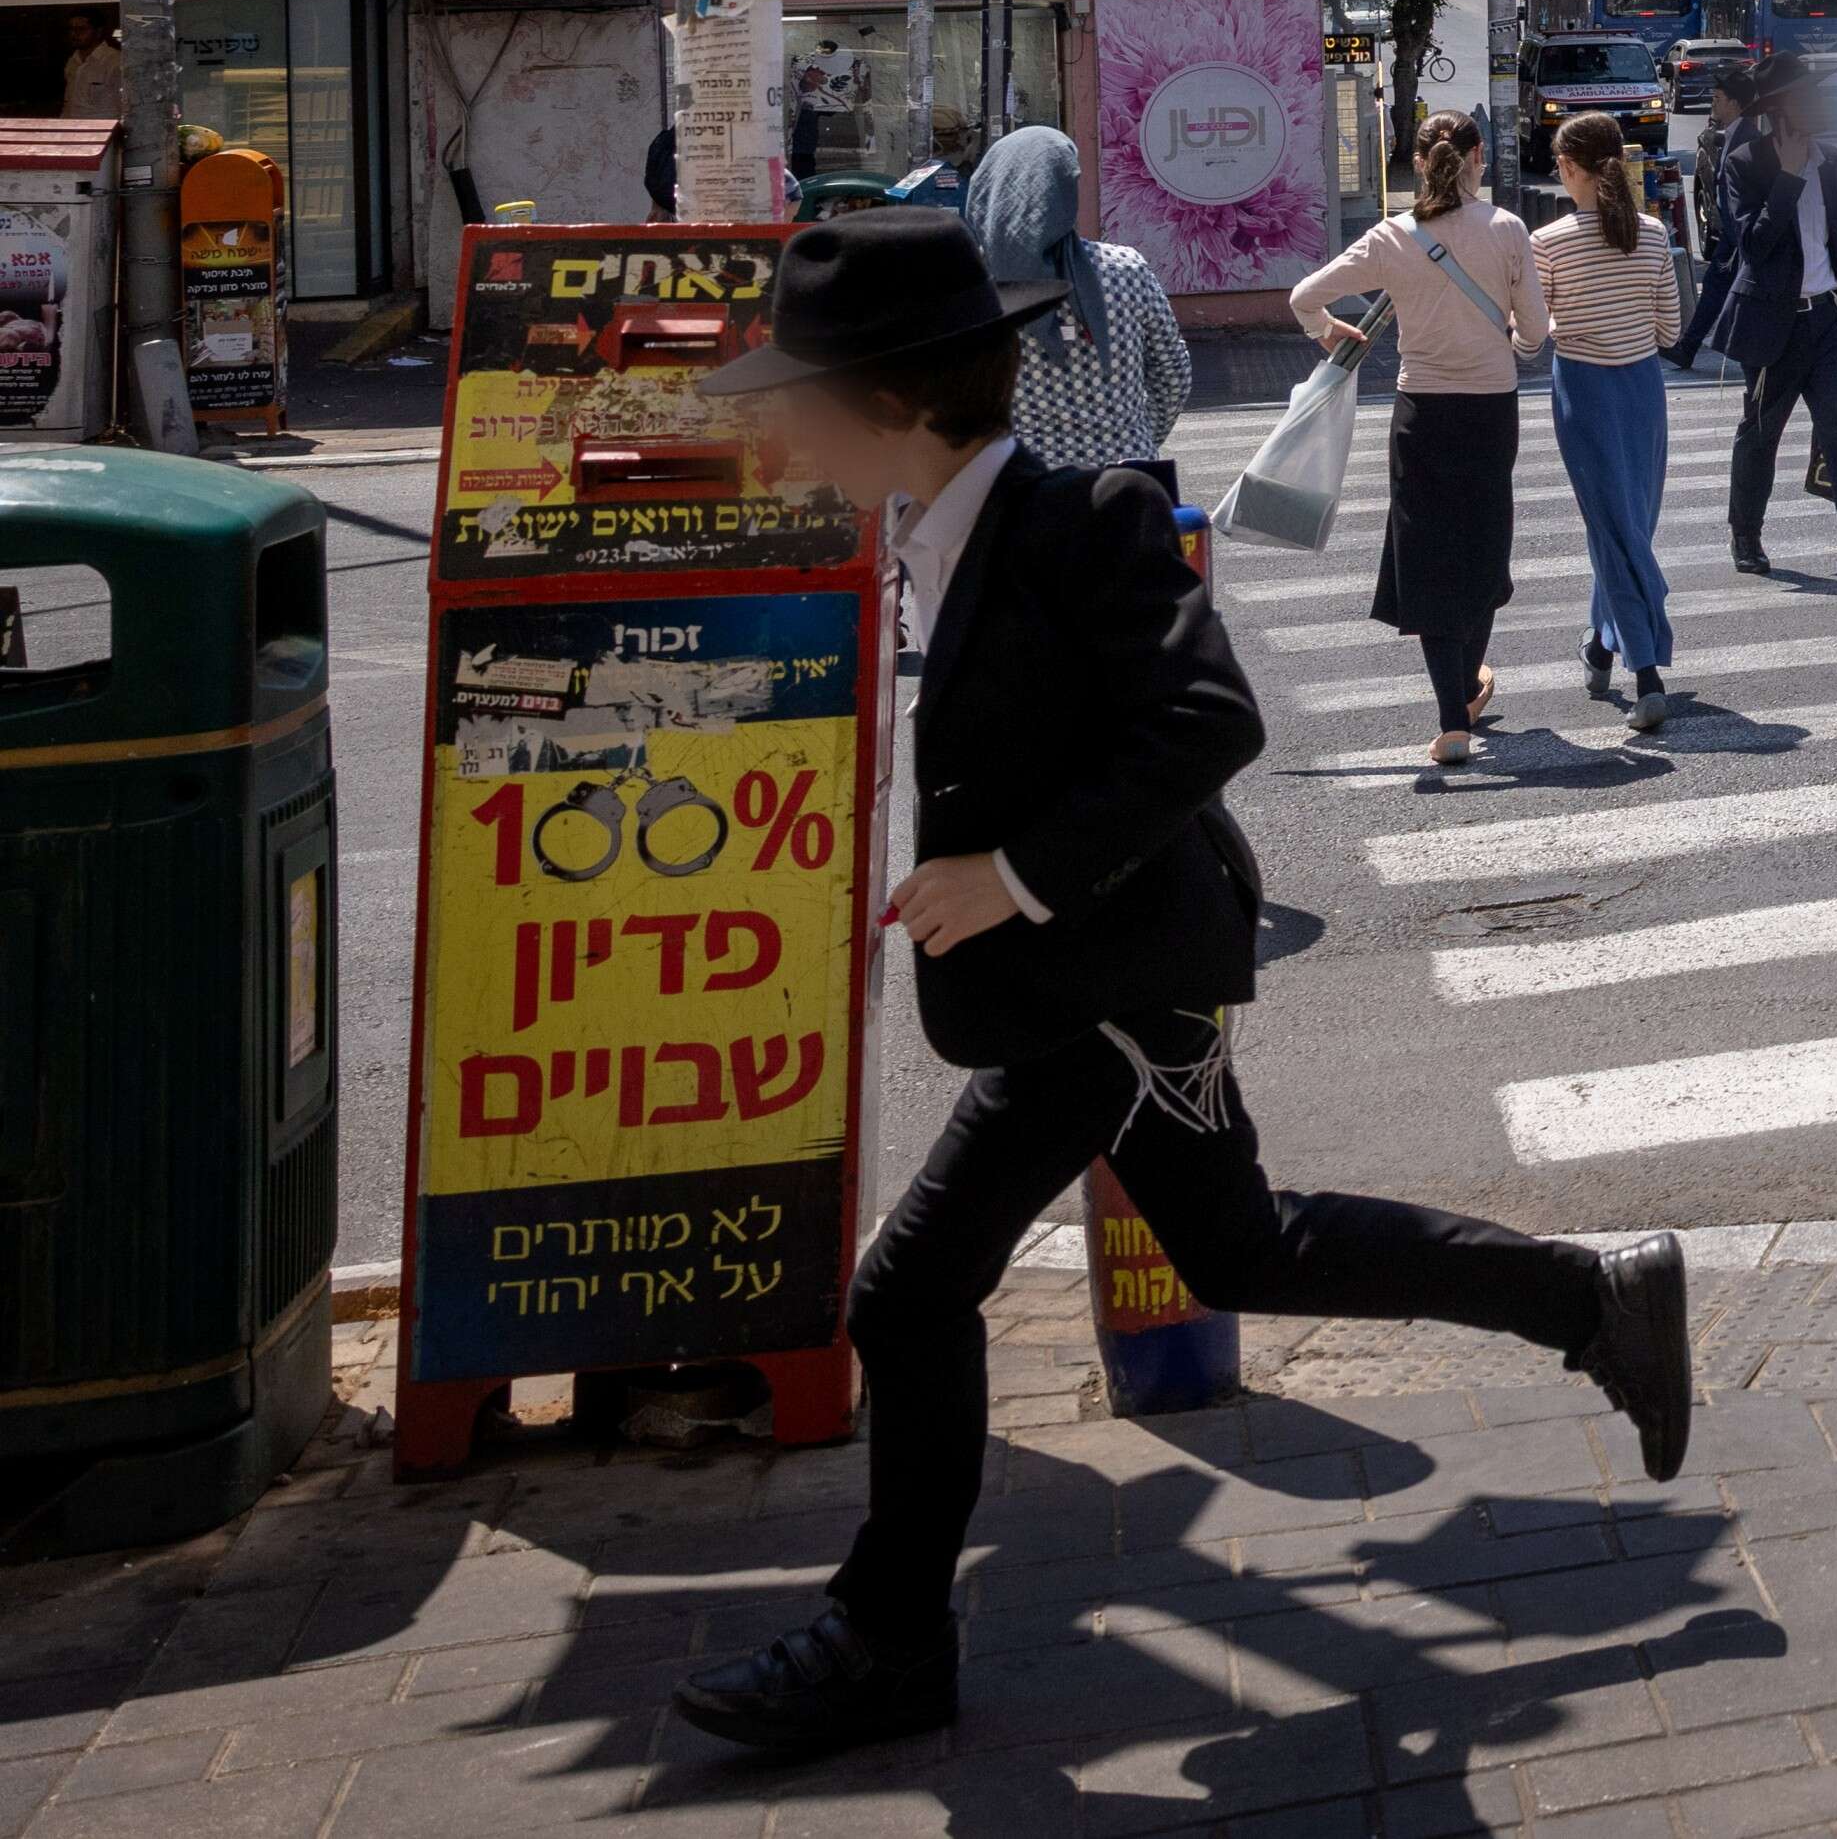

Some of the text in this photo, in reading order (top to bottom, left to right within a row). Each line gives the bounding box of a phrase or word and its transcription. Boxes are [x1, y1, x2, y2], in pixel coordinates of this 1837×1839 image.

[1567, 89, 1639, 97] AMBULANCE
[1163, 105, 1266, 162] JUDI
[11, 251, 52, 267] אמא
[190, 248, 222, 261] משה
[455, 503, 706, 543] ורואים ישות
[614, 622, 703, 653] זכור!
[512, 909, 783, 1032] פדיון
[458, 1030, 825, 1139] שבויים
[492, 1194, 783, 1262] לא מוותרים
[487, 1254, 783, 1317] על אף יהודי
[1111, 1265, 1192, 1315] קות
